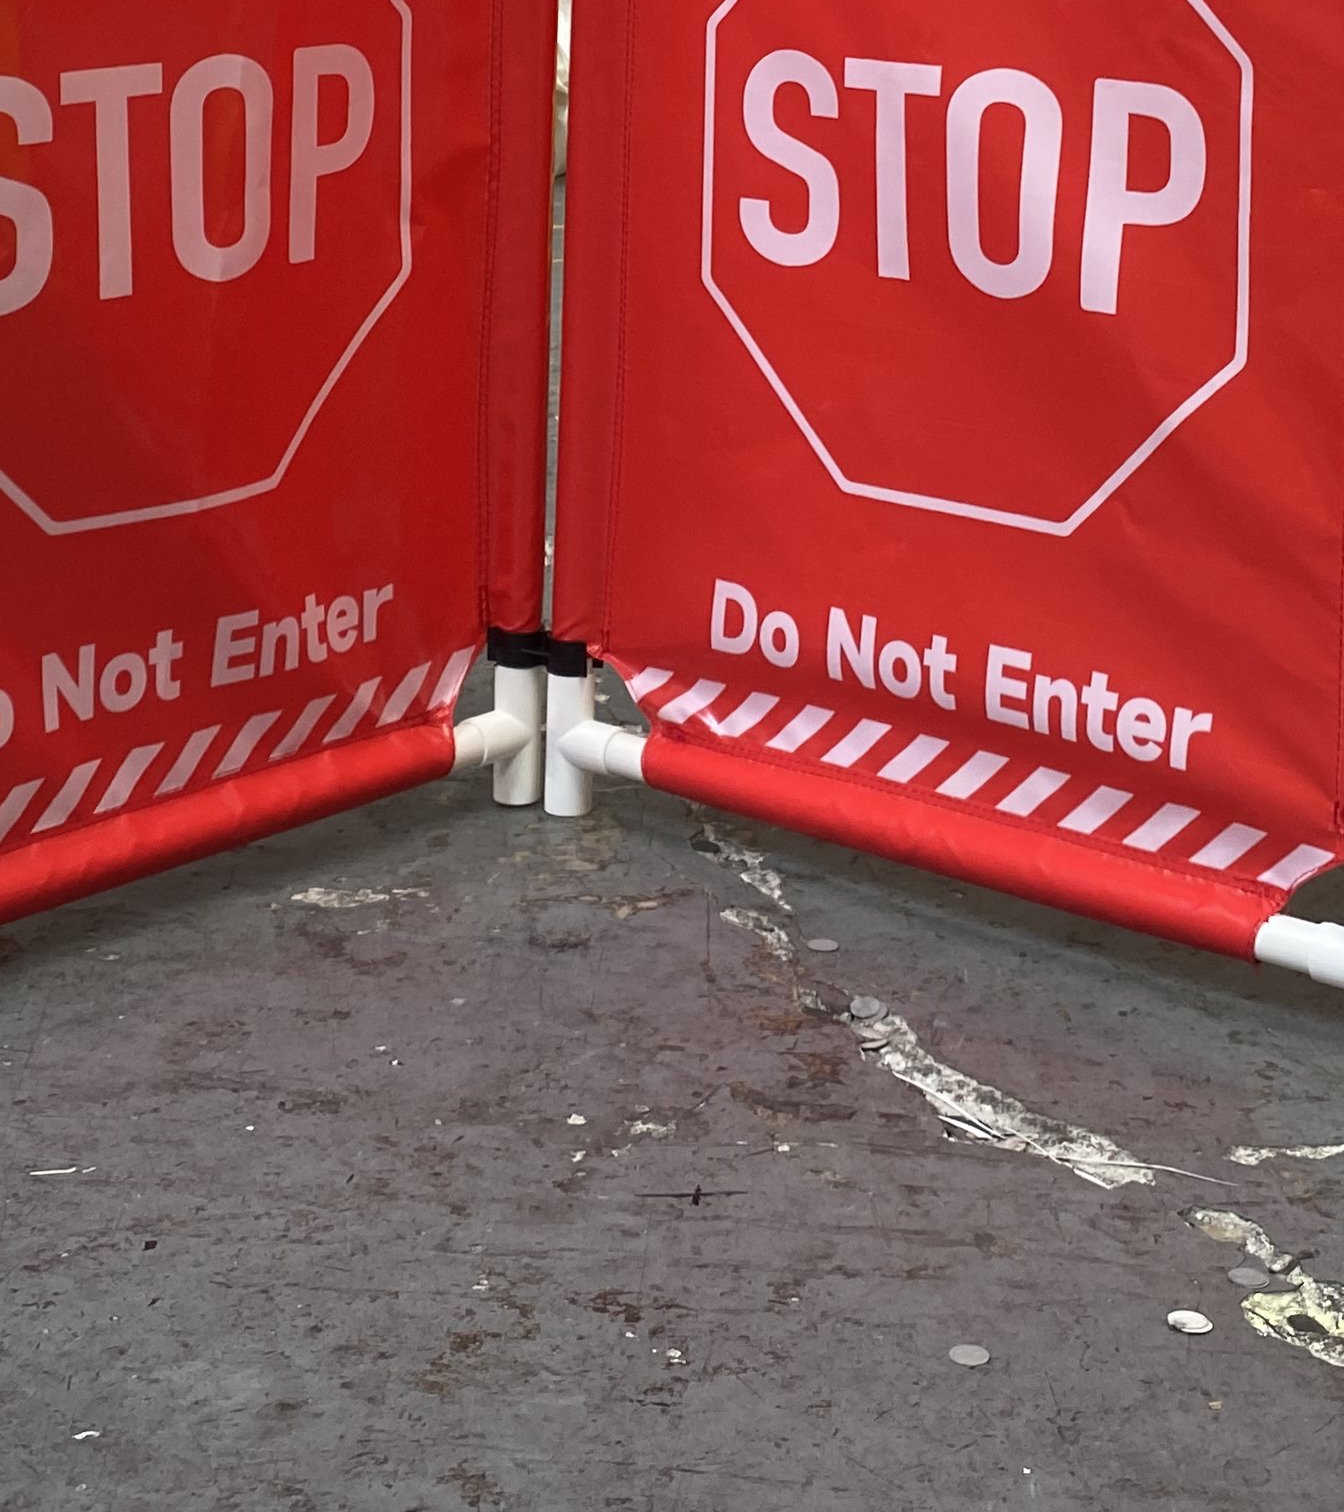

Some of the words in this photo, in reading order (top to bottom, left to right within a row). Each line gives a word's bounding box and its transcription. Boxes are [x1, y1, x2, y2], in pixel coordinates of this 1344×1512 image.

[739, 49, 1207, 315] STOP
[41, 628, 184, 734] Not
[210, 583, 394, 688] Enter
[710, 578, 800, 668] Do
[826, 605, 957, 711] Not
[985, 643, 1214, 771] Enter
